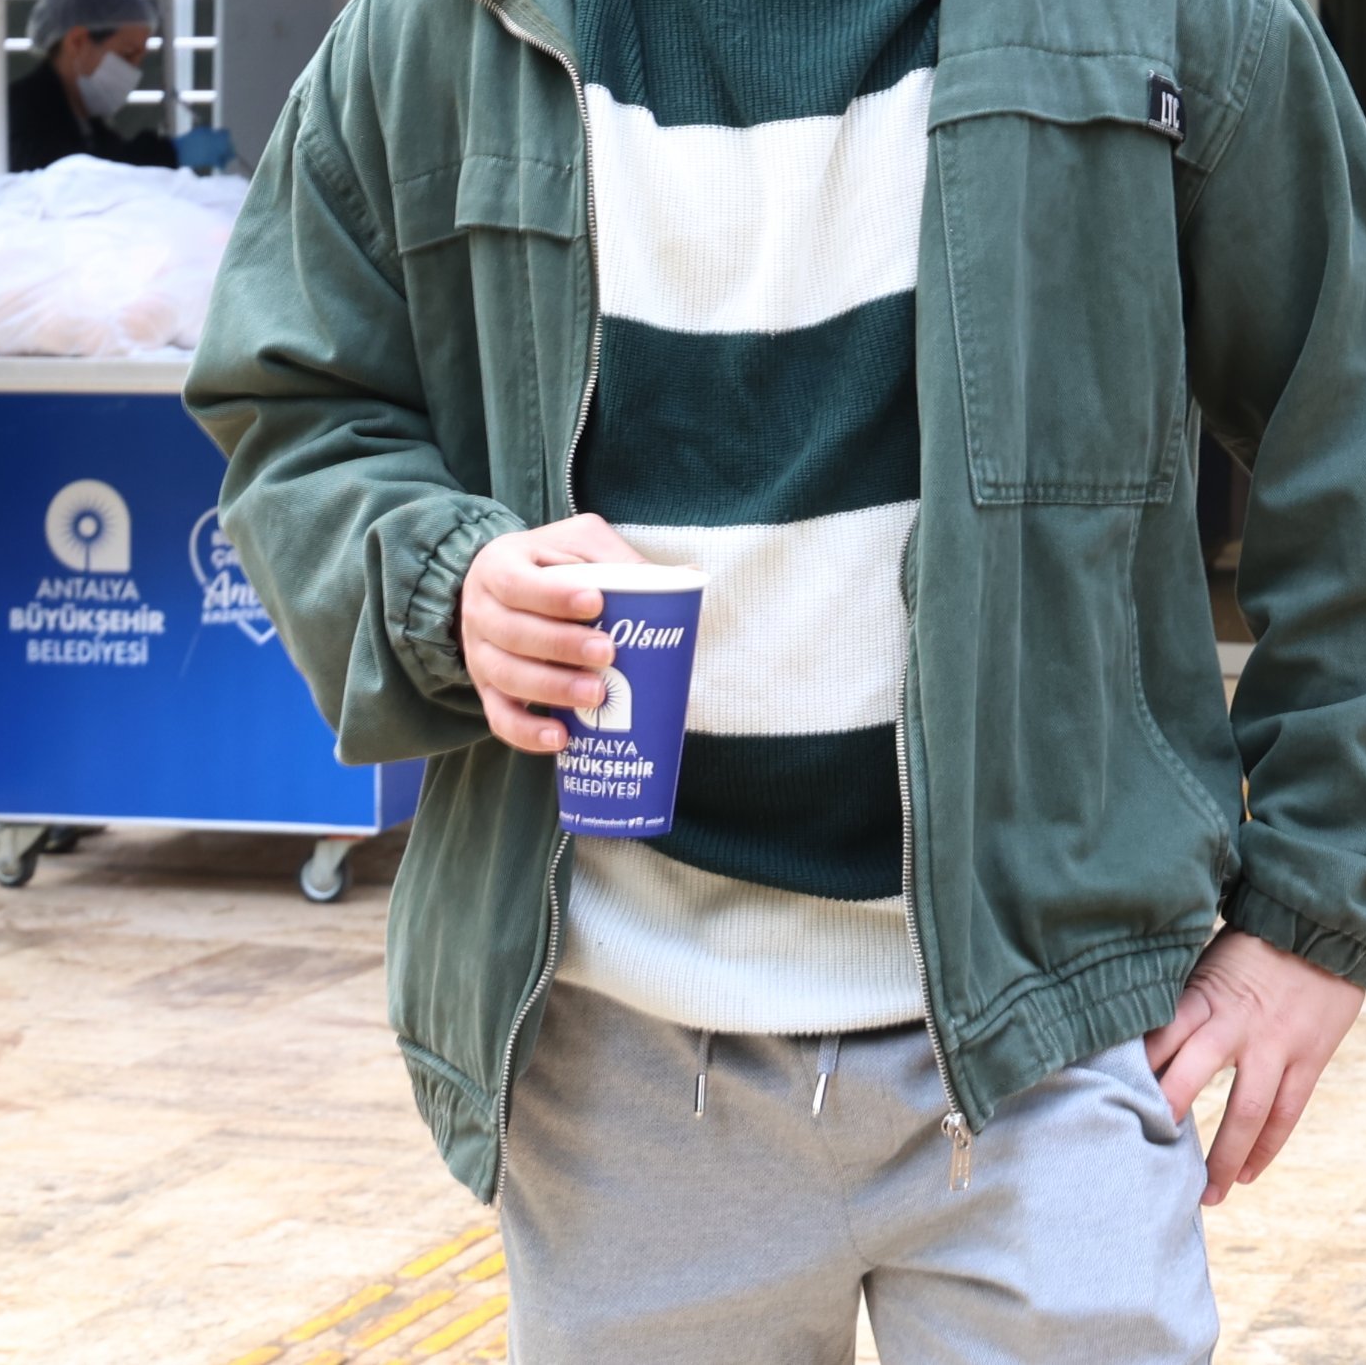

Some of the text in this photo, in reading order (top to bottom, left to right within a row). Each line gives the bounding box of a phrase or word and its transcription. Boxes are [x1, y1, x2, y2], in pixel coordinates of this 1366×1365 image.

[1161, 91, 1180, 130] LTC
[36, 577, 140, 601] ANTALYA
[9, 601, 166, 638] BÜYÜKŞEHİR
[610, 618, 684, 649] Olsun
[26, 635, 149, 665] BELEDİYESİ
[566, 736, 638, 757] ANTALYA
[563, 775, 642, 799] BELEDİYESİ
